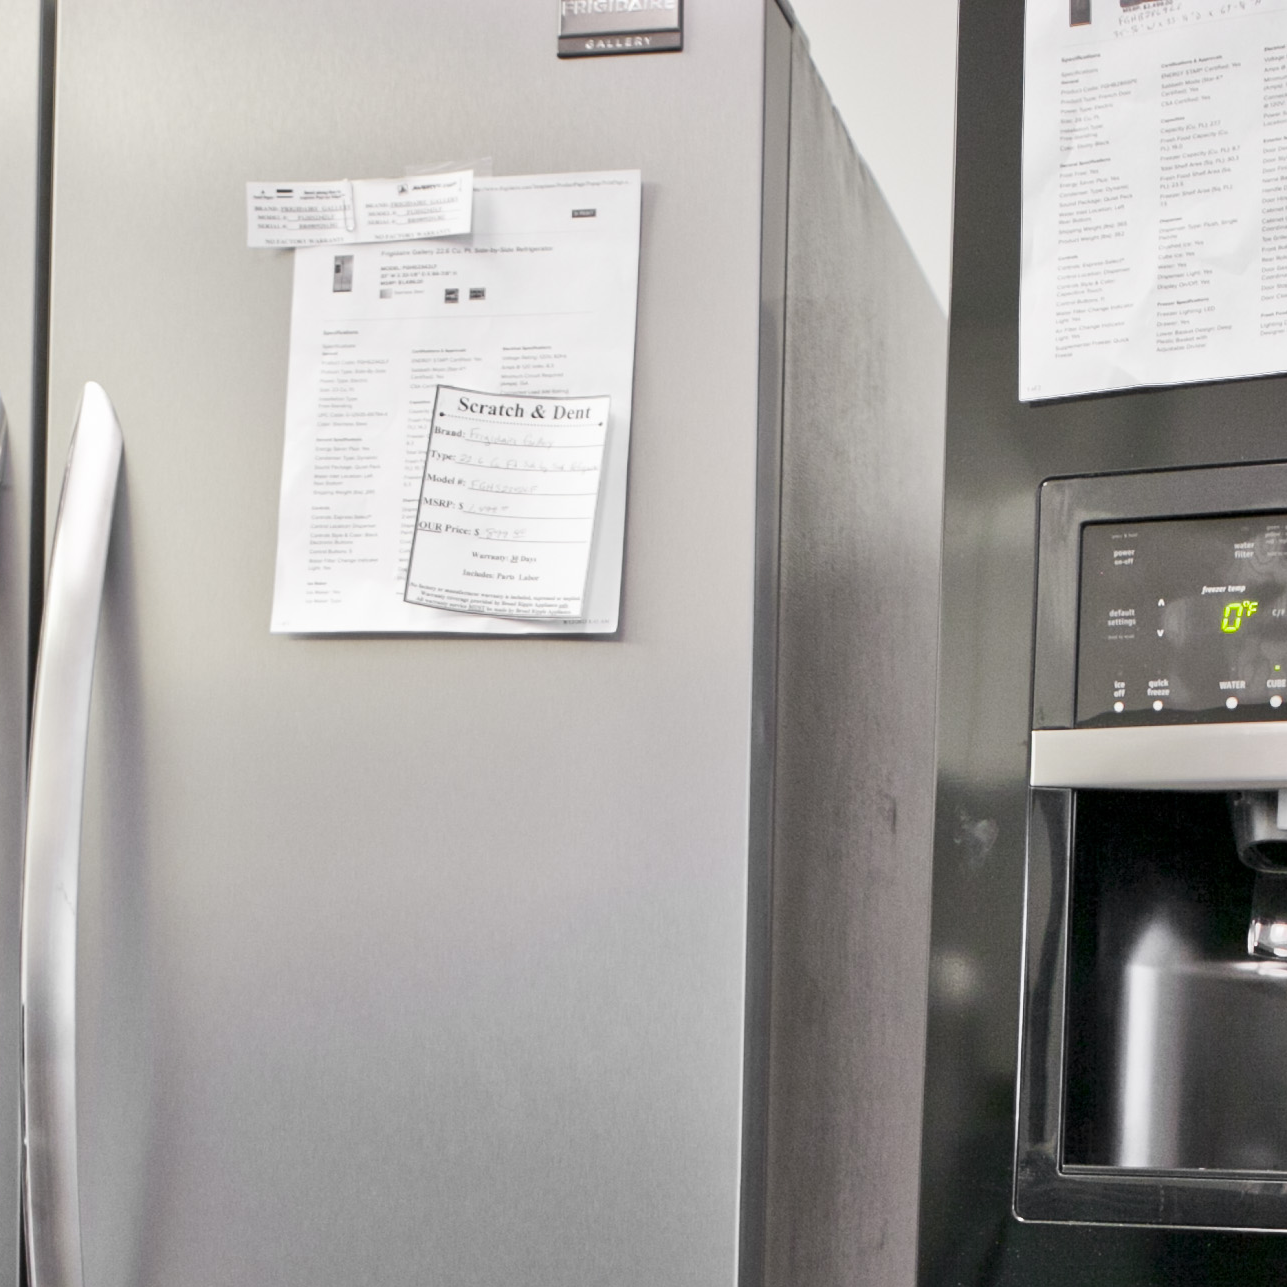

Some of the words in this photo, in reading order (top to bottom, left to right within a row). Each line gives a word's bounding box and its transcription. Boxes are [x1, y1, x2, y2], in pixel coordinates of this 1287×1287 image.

[585, 36, 652, 50] GALLERY
[457, 397, 525, 418] Scratch
[531, 404, 546, 419] &
[553, 405, 591, 420] Dent
[434, 426, 466, 438] Brand:
[430, 450, 456, 461] Type:
[427, 473, 454, 485] Model
[423, 497, 455, 509] MSRP:
[458, 501, 463, 510] $
[419, 521, 442, 531] OUR
[445, 524, 471, 535] Price:
[474, 528, 480, 537] $
[1234, 541, 1255, 550] water
[472, 551, 508, 561] Warranty:
[520, 555, 537, 563] Days
[1234, 550, 1255, 559] filter
[462, 569, 494, 579] Includes:
[519, 574, 540, 582] Labor
[1201, 585, 1226, 595] freezer
[1228, 584, 1246, 593] temp
[1109, 609, 1135, 617] default
[1108, 618, 1136, 626] settings
[1114, 680, 1125, 689] ice
[1148, 678, 1169, 689] quick
[1219, 680, 1246, 689] WATER
[1266, 678, 1287, 688] CUBE
[1114, 688, 1125, 698] off
[1147, 688, 1170, 697] freeze
